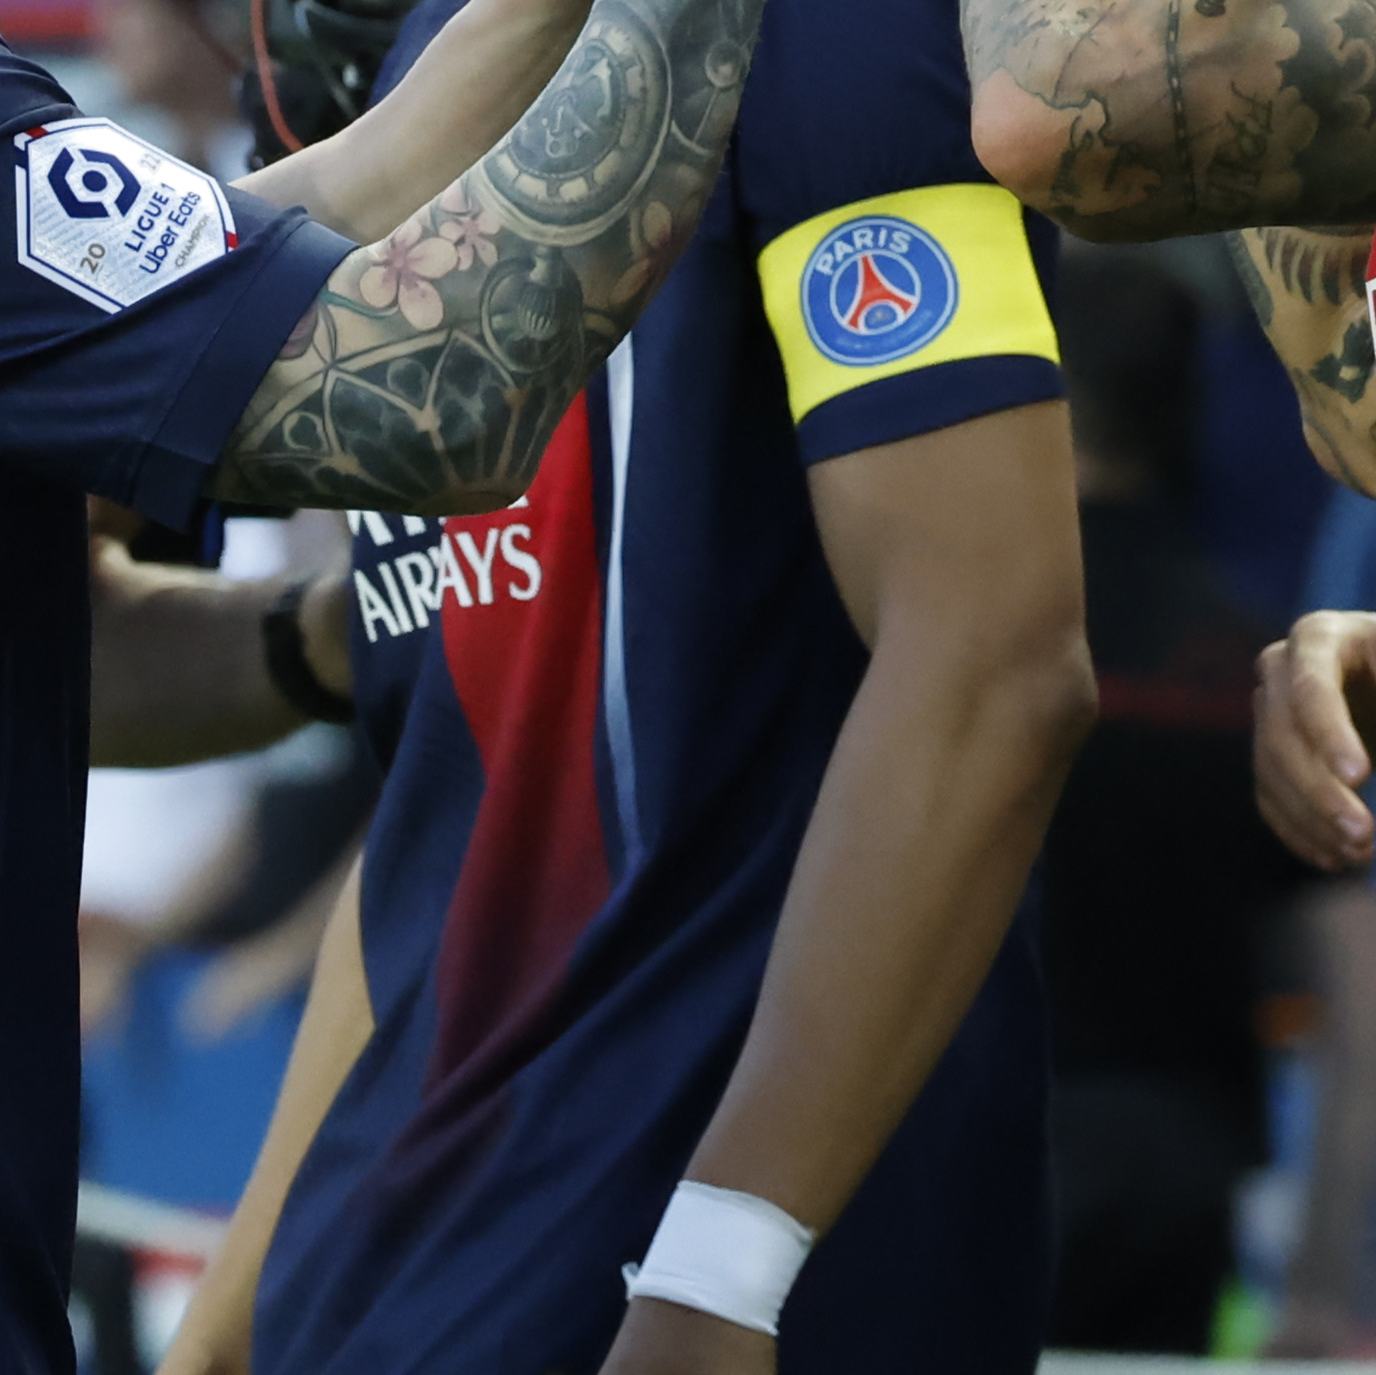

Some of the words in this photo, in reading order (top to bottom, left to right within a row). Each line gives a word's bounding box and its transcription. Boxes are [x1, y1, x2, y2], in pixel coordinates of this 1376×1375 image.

[125, 190, 170, 252] LIGUE
[161, 181, 176, 192] 1
[139, 224, 179, 274] Uber
[168, 191, 201, 227] Eats
[80, 242, 106, 274] 20
[815, 227, 912, 276] PARIS
